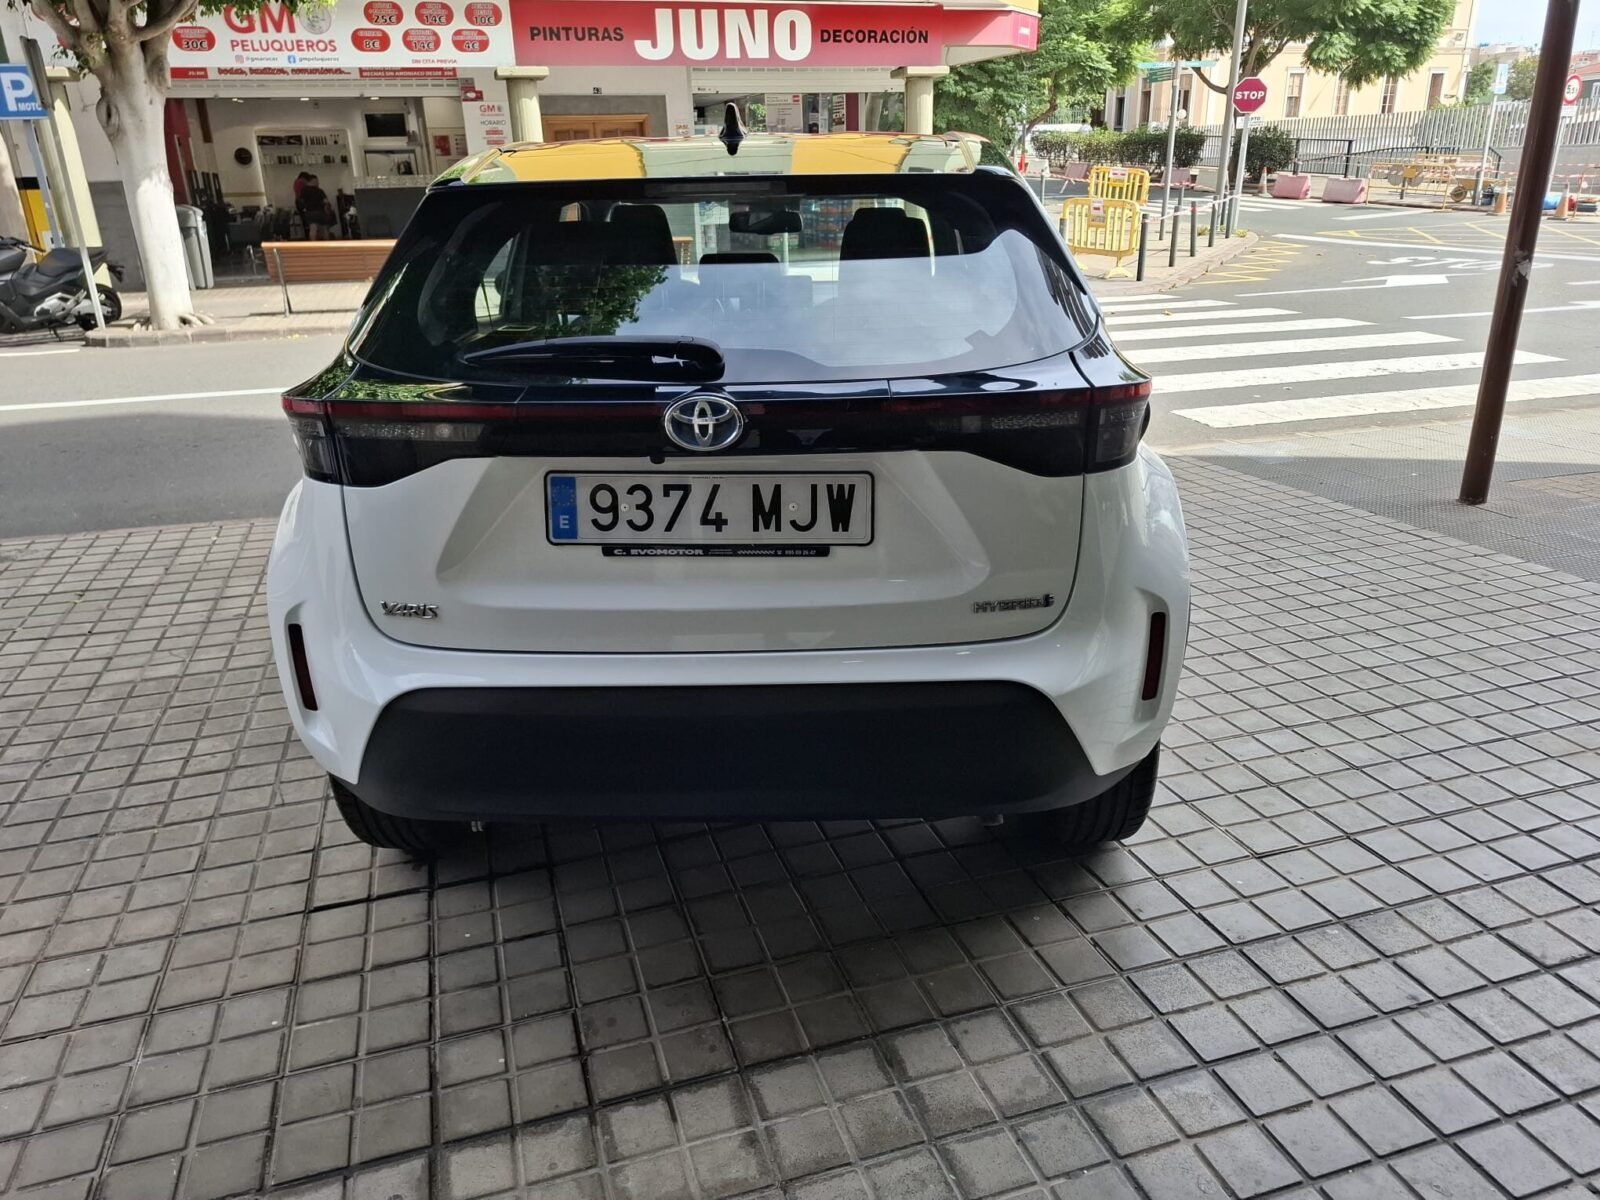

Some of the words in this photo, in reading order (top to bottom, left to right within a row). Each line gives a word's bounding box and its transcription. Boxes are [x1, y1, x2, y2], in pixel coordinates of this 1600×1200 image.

[223, 0, 296, 34] GM
[374, 15, 396, 24] 25€
[425, 15, 445, 24] 14€
[474, 16, 494, 25] 10€
[529, 26, 624, 42] PINTURAS
[633, 8, 812, 61] JUNO
[820, 27, 929, 44] DECORACIÓN
[183, 40, 208, 50] 30€
[230, 39, 337, 52] PELUQUEROS
[364, 40, 380, 49] 8€
[0, 72, 33, 112] P
[1235, 90, 1265, 100] STOP
[480, 104, 496, 113] GM
[589, 483, 728, 533] 9374
[752, 483, 856, 533] MJW
[559, 515, 569, 529] E
[380, 600, 438, 619] YARIS
[973, 598, 1043, 613] HYBRID
